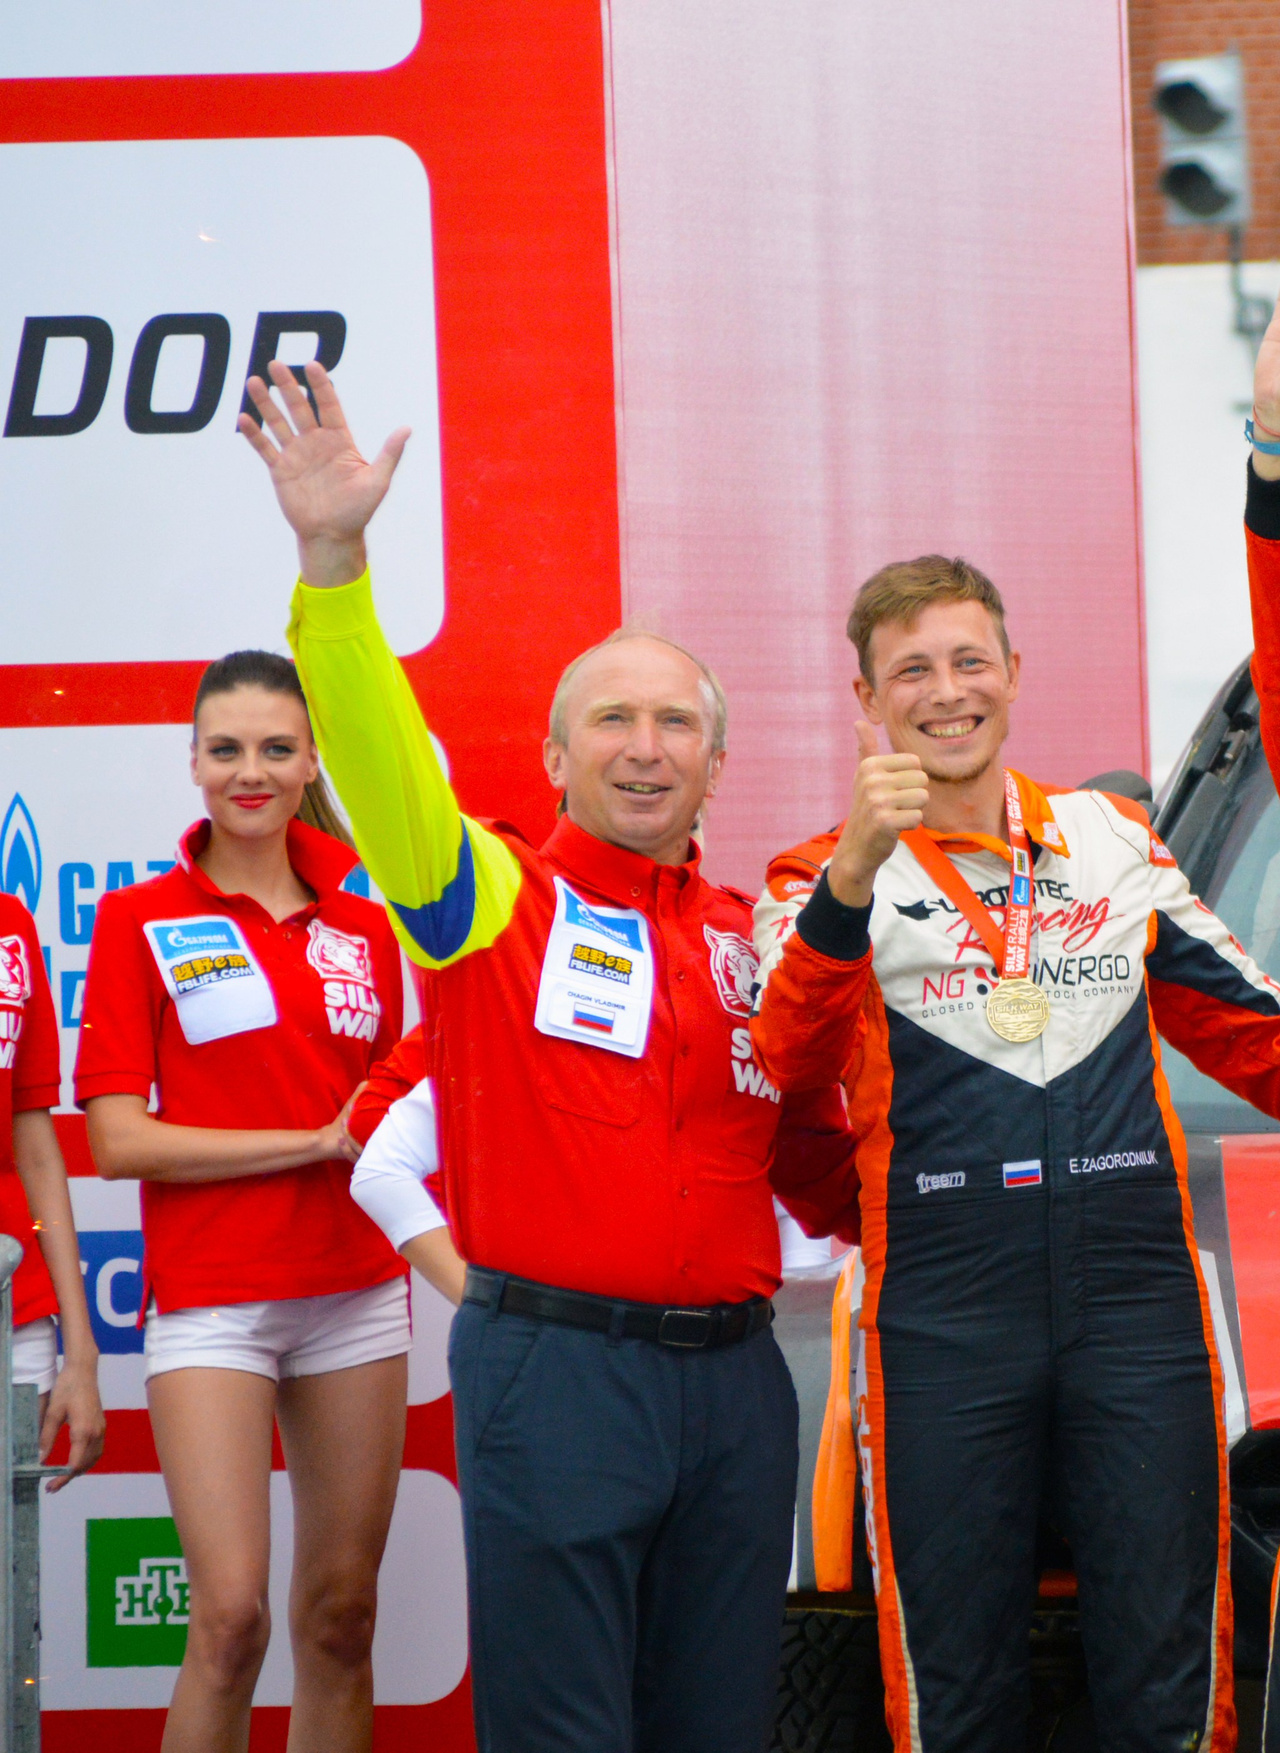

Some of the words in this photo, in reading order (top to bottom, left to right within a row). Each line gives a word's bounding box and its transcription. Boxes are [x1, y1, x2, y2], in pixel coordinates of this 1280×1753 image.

[3, 310, 346, 437] DOR
[1008, 907, 1020, 944] RALLY
[569, 958, 630, 984] FBLIFE.COM
[1005, 945, 1017, 973] SILK
[1015, 946, 1027, 973] WAY
[176, 967, 254, 994] FBLIFE.COM
[922, 969, 968, 1005] NG
[921, 1001, 975, 1019] CLOSED
[1083, 985, 1136, 998] COMPANY
[916, 1171, 965, 1194] freem
